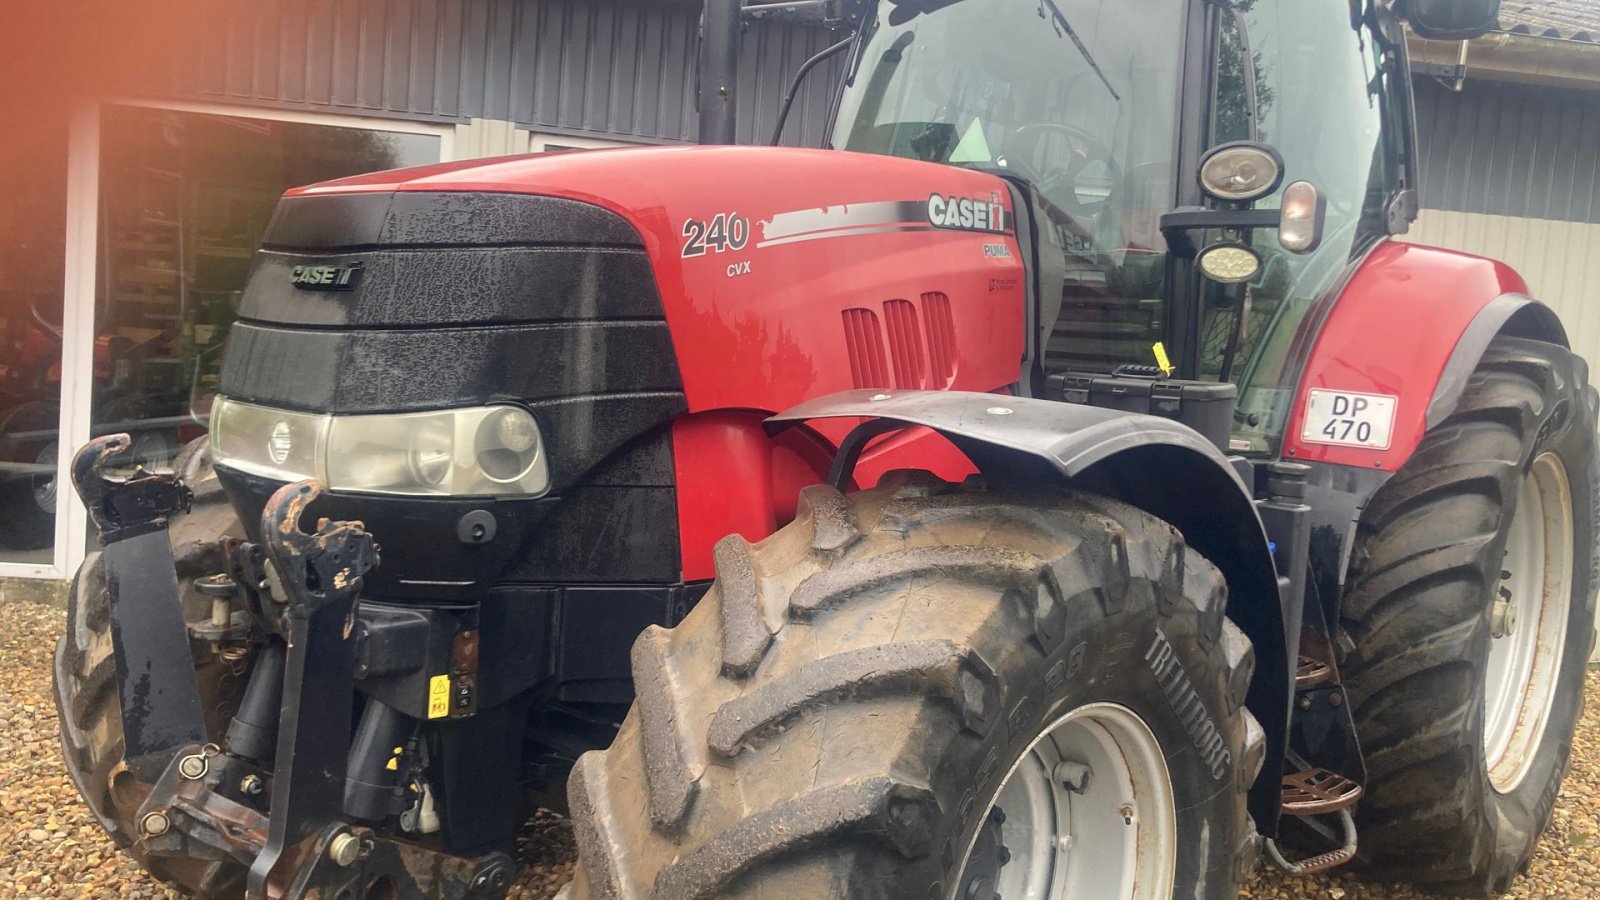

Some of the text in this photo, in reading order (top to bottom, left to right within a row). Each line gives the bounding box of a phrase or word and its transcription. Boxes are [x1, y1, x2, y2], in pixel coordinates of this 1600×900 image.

[929, 193, 986, 228] CASE
[681, 212, 750, 258] 240
[983, 244, 1011, 257] PUMA
[290, 265, 336, 284] CASE
[726, 260, 752, 278] CVX
[1332, 396, 1368, 417] DP
[1322, 418, 1371, 442] 470
